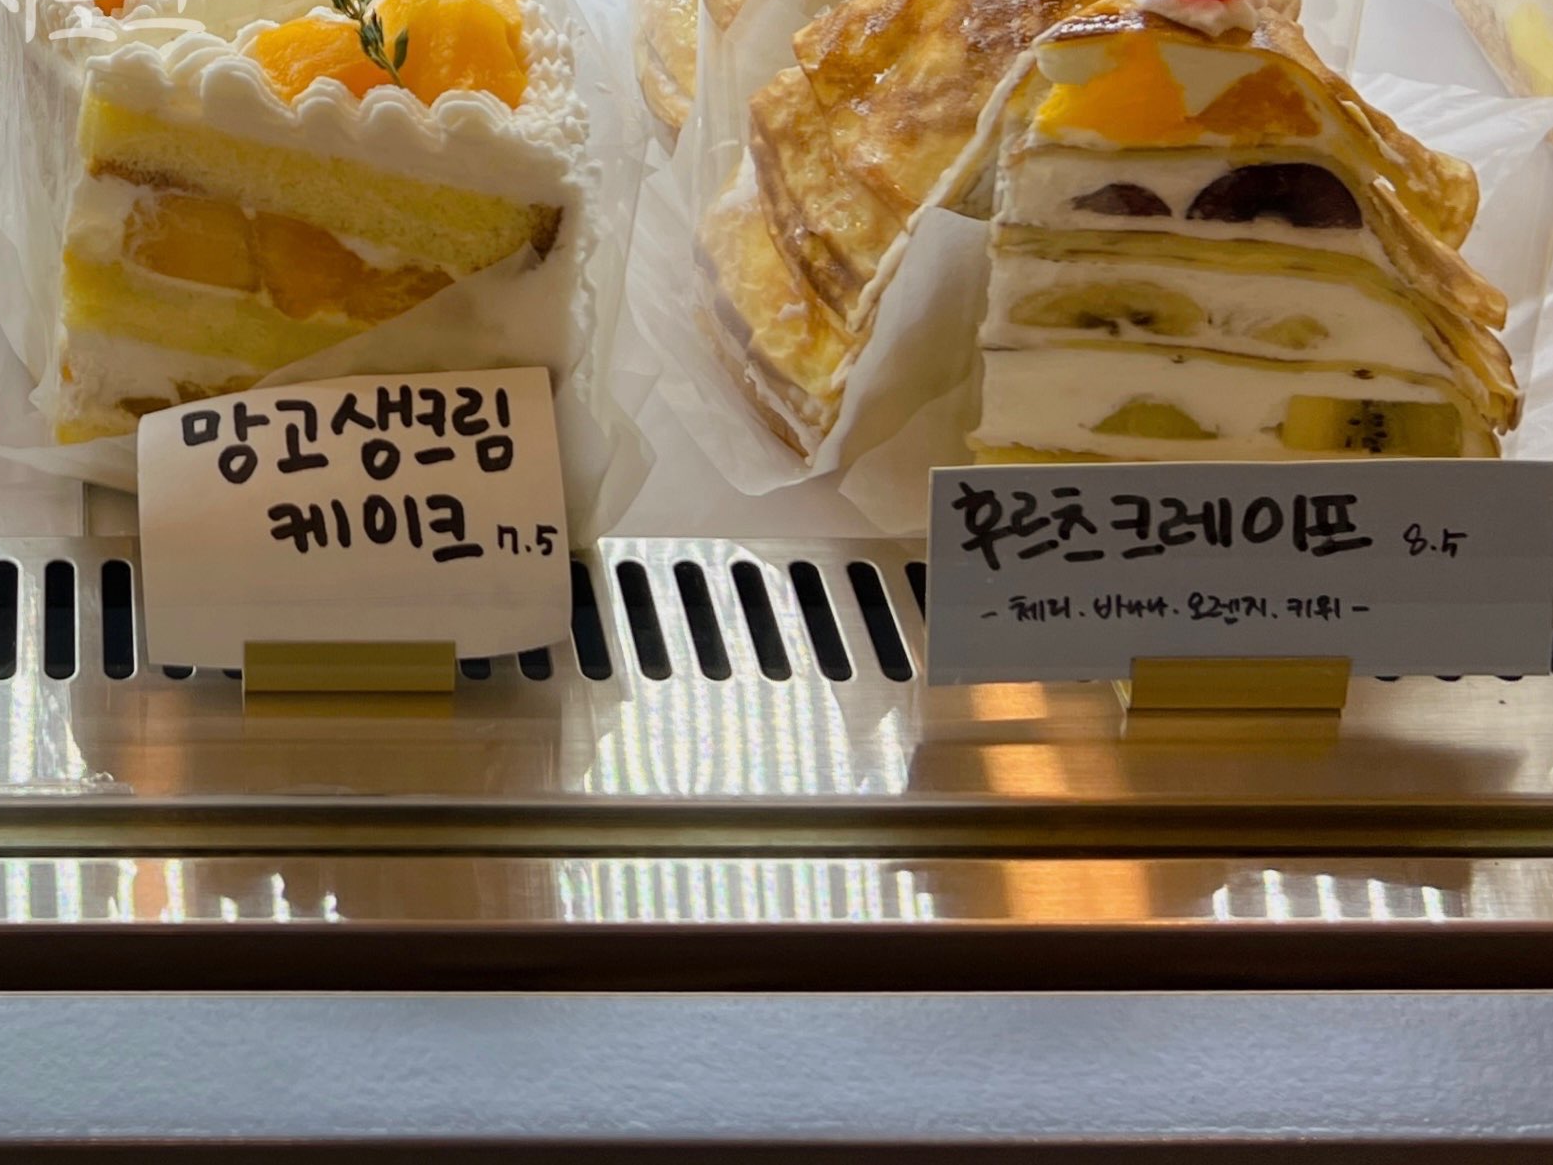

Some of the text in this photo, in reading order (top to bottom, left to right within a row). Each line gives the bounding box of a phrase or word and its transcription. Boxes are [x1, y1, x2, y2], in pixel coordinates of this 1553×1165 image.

[181, 384, 515, 485] 망고생크림
[267, 493, 559, 564] 케이크 7.5
[1402, 522, 1468, 558] 8.5
